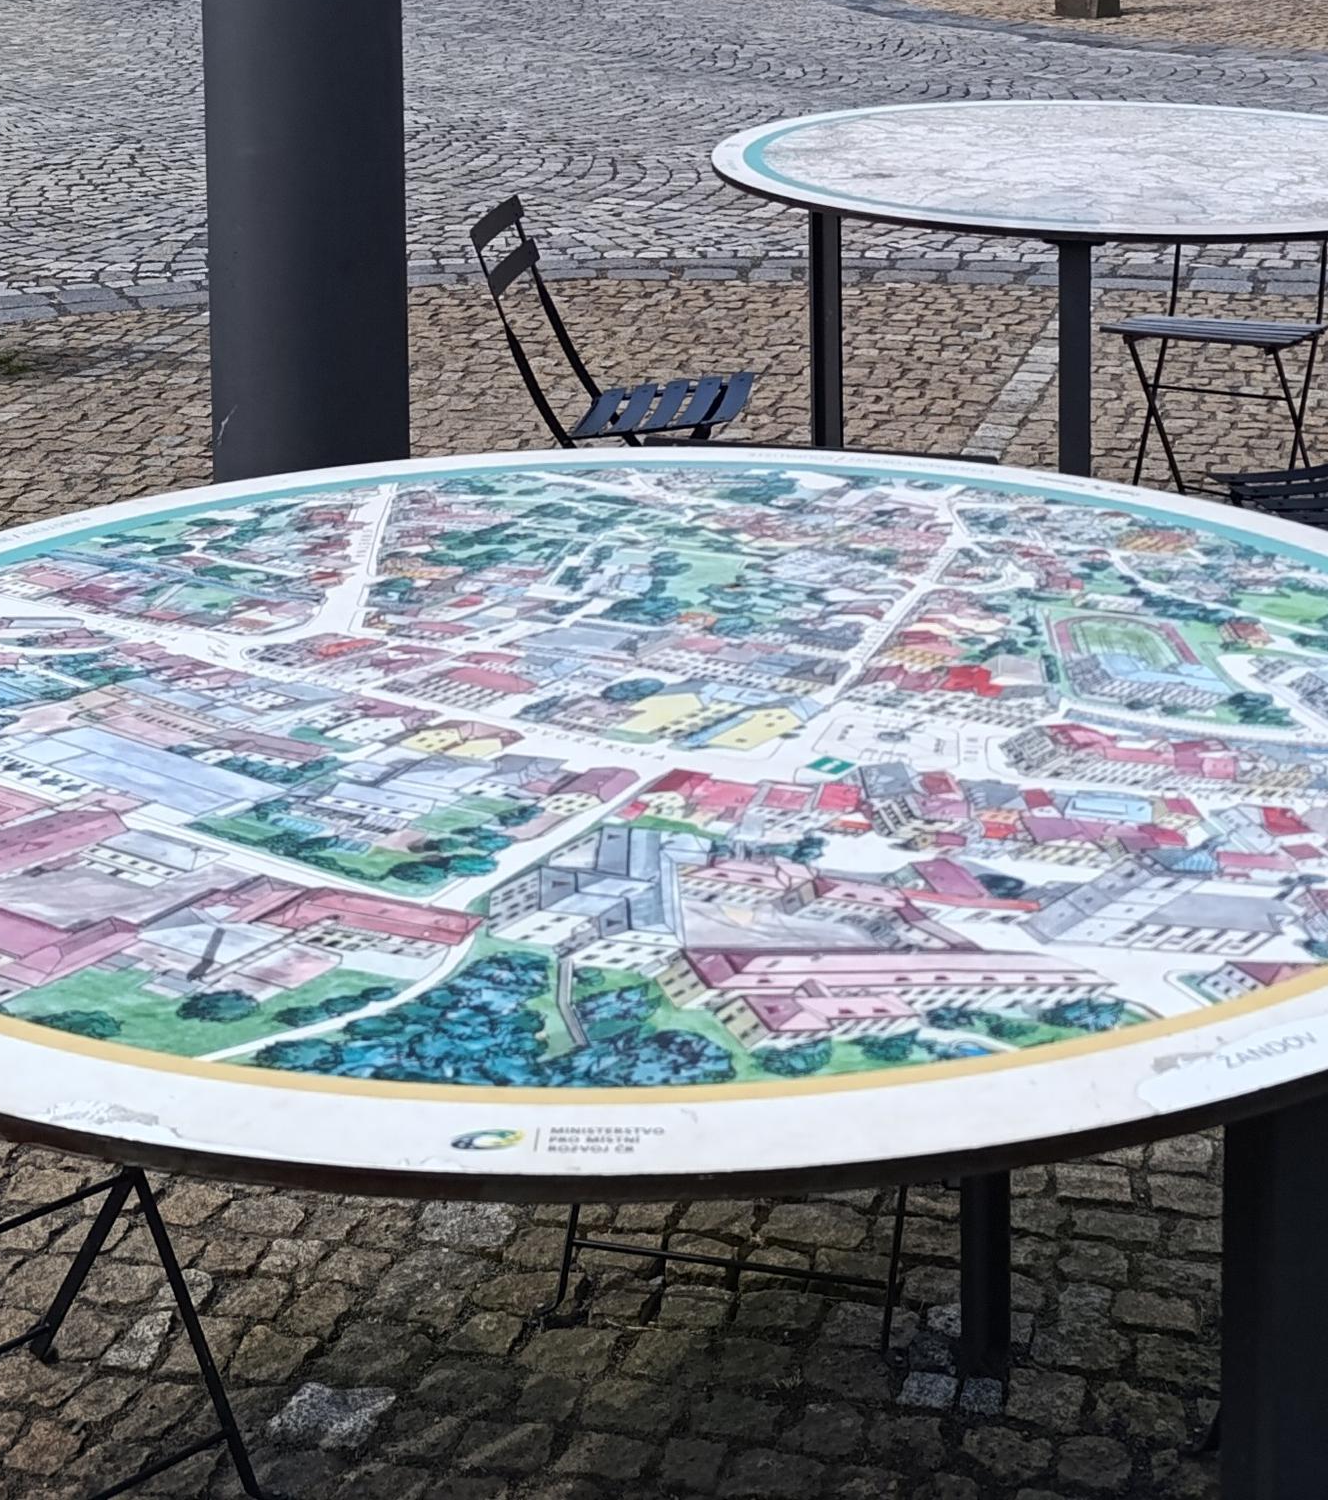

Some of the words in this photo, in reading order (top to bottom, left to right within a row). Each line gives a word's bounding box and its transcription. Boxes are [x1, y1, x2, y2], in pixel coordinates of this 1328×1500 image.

[550, 1126, 665, 1135] MINISTERSTVO
[548, 1135, 580, 1143] PRO
[548, 1144, 609, 1153] ROZVOJ
